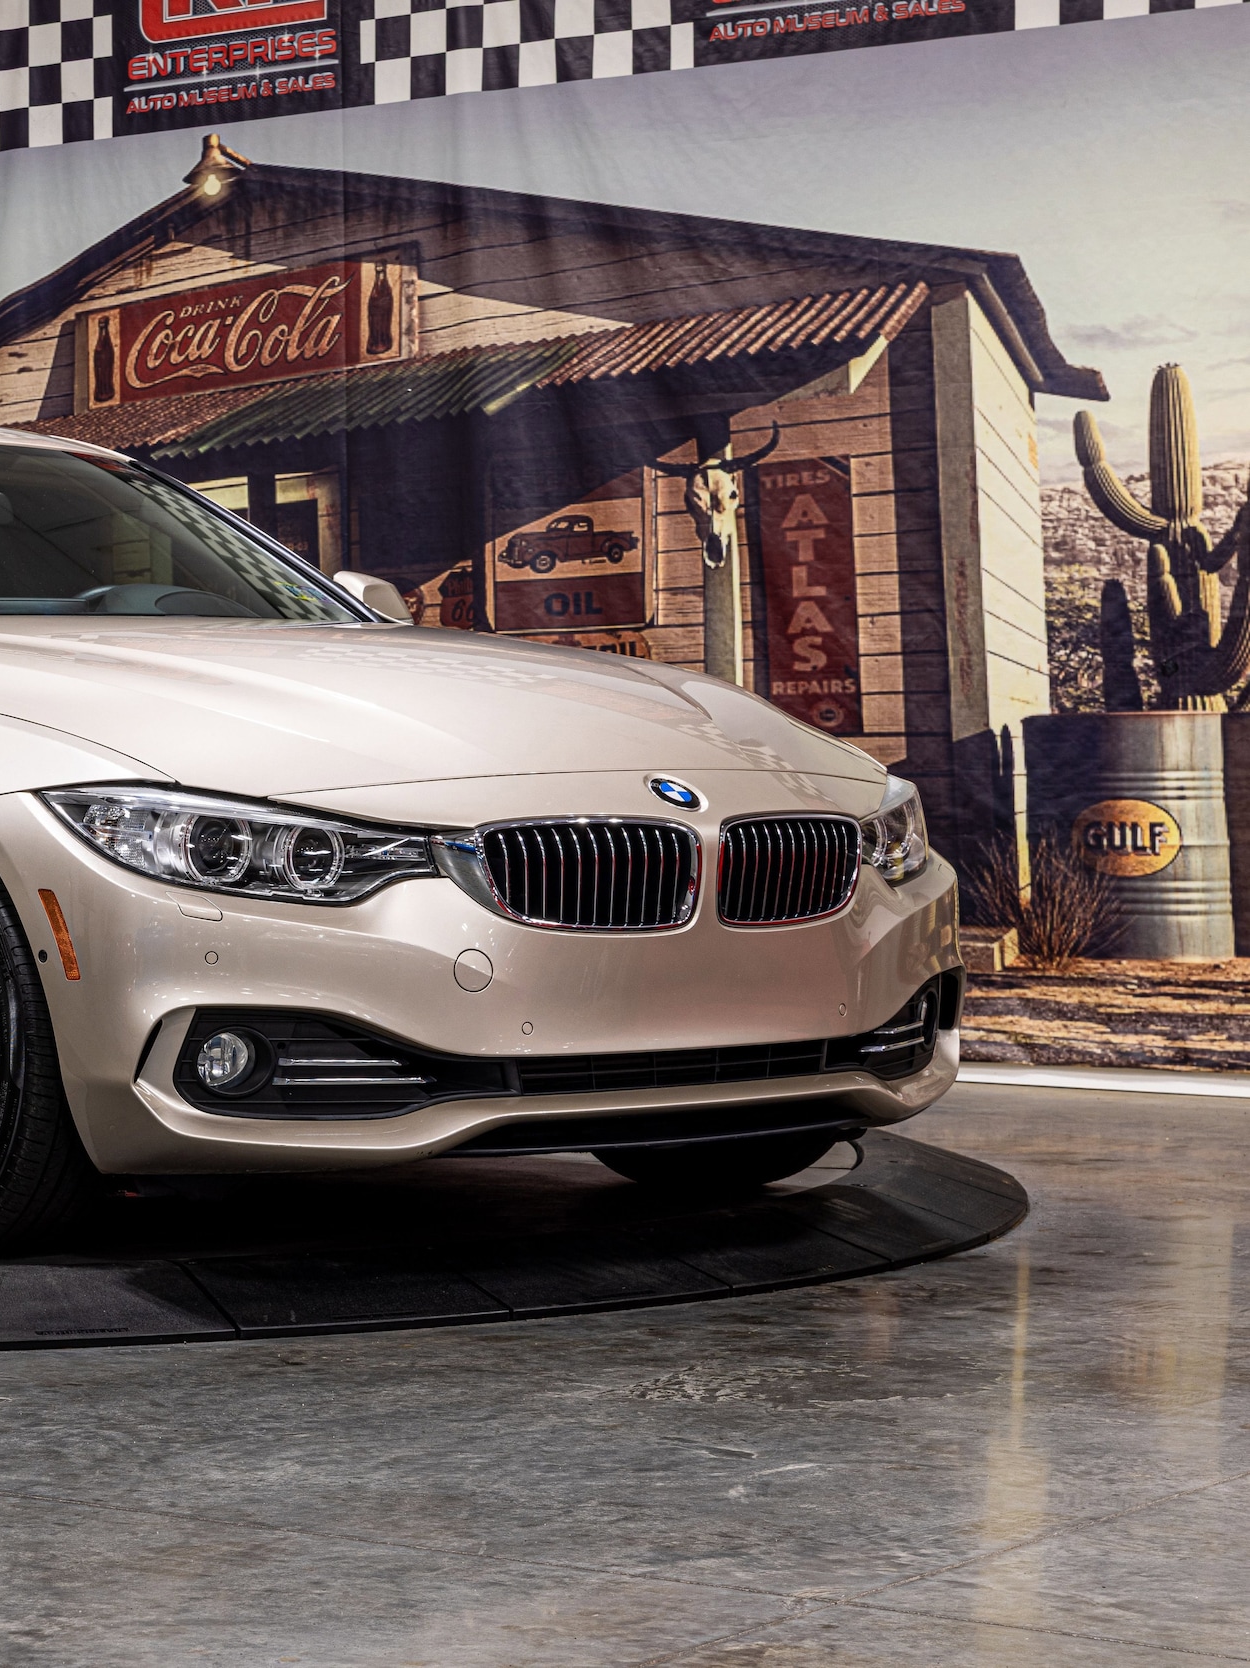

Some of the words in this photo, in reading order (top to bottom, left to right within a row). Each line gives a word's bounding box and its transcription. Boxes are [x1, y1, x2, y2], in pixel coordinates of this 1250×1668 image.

[709, 20, 771, 42] AUTO
[772, 6, 869, 35] MUSEUM
[873, 2, 889, 22] &
[892, 0, 966, 19] SALES
[127, 28, 337, 81] ENTERPRISES
[126, 93, 177, 114] AUTO
[178, 82, 258, 108] MUSEUM
[260, 79, 273, 97] &
[274, 72, 336, 95] SALES
[179, 295, 243, 318] DRINK
[125, 275, 354, 389] Coca-Cola
[761, 469, 831, 489] TIRES
[781, 493, 834, 671] ATLAS
[544, 591, 603, 616] OIL
[772, 677, 857, 696] REPAIRS
[1082, 821, 1169, 856] GULF
